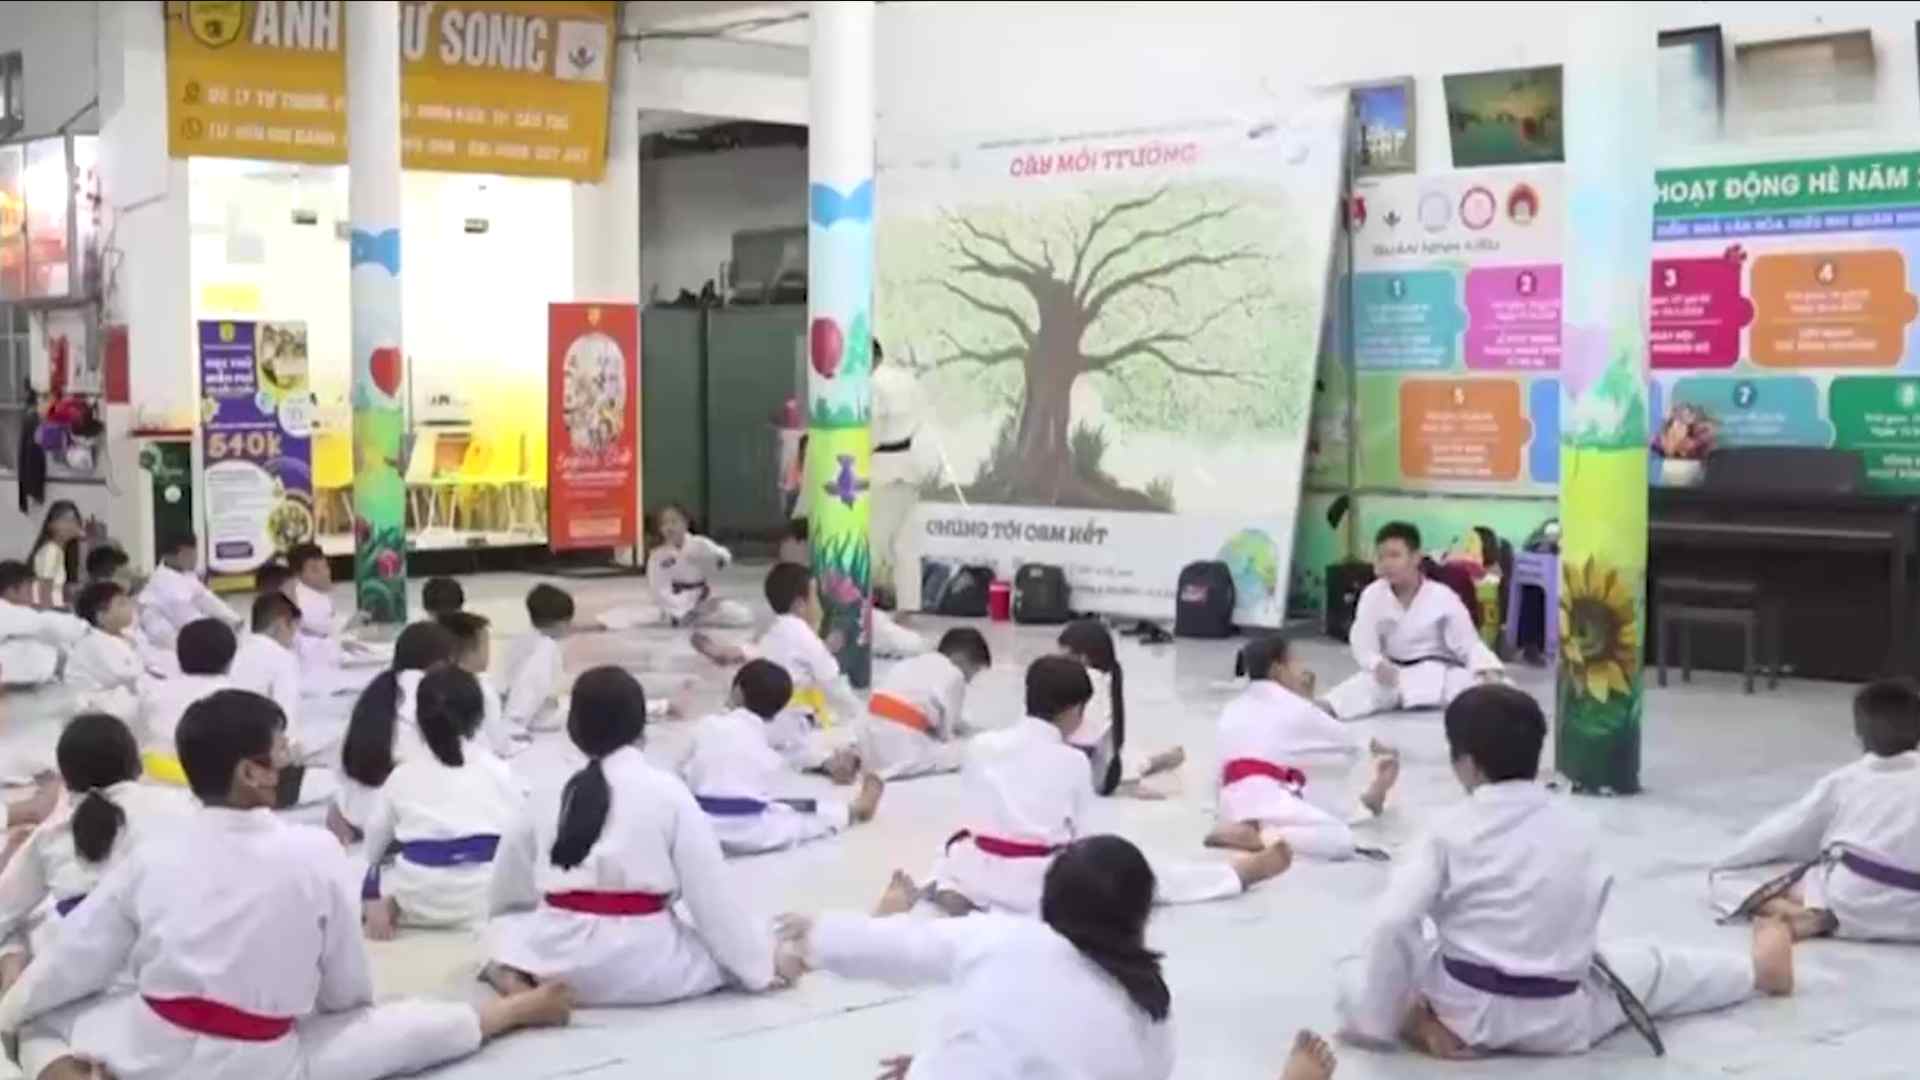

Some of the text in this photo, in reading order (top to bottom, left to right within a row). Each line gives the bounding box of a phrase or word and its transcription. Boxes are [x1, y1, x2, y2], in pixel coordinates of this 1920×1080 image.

[252, 2, 338, 52] ANH
[440, 9, 548, 72] SONIC
[1724, 171, 1799, 204] ĐỘNG
[1808, 165, 1840, 193] HÈ
[1848, 163, 1909, 192] NĂM
[1664, 268, 1677, 287] 3
[1818, 263, 1833, 282] 4
[1392, 279, 1401, 297] 1
[1520, 275, 1532, 293] 2
